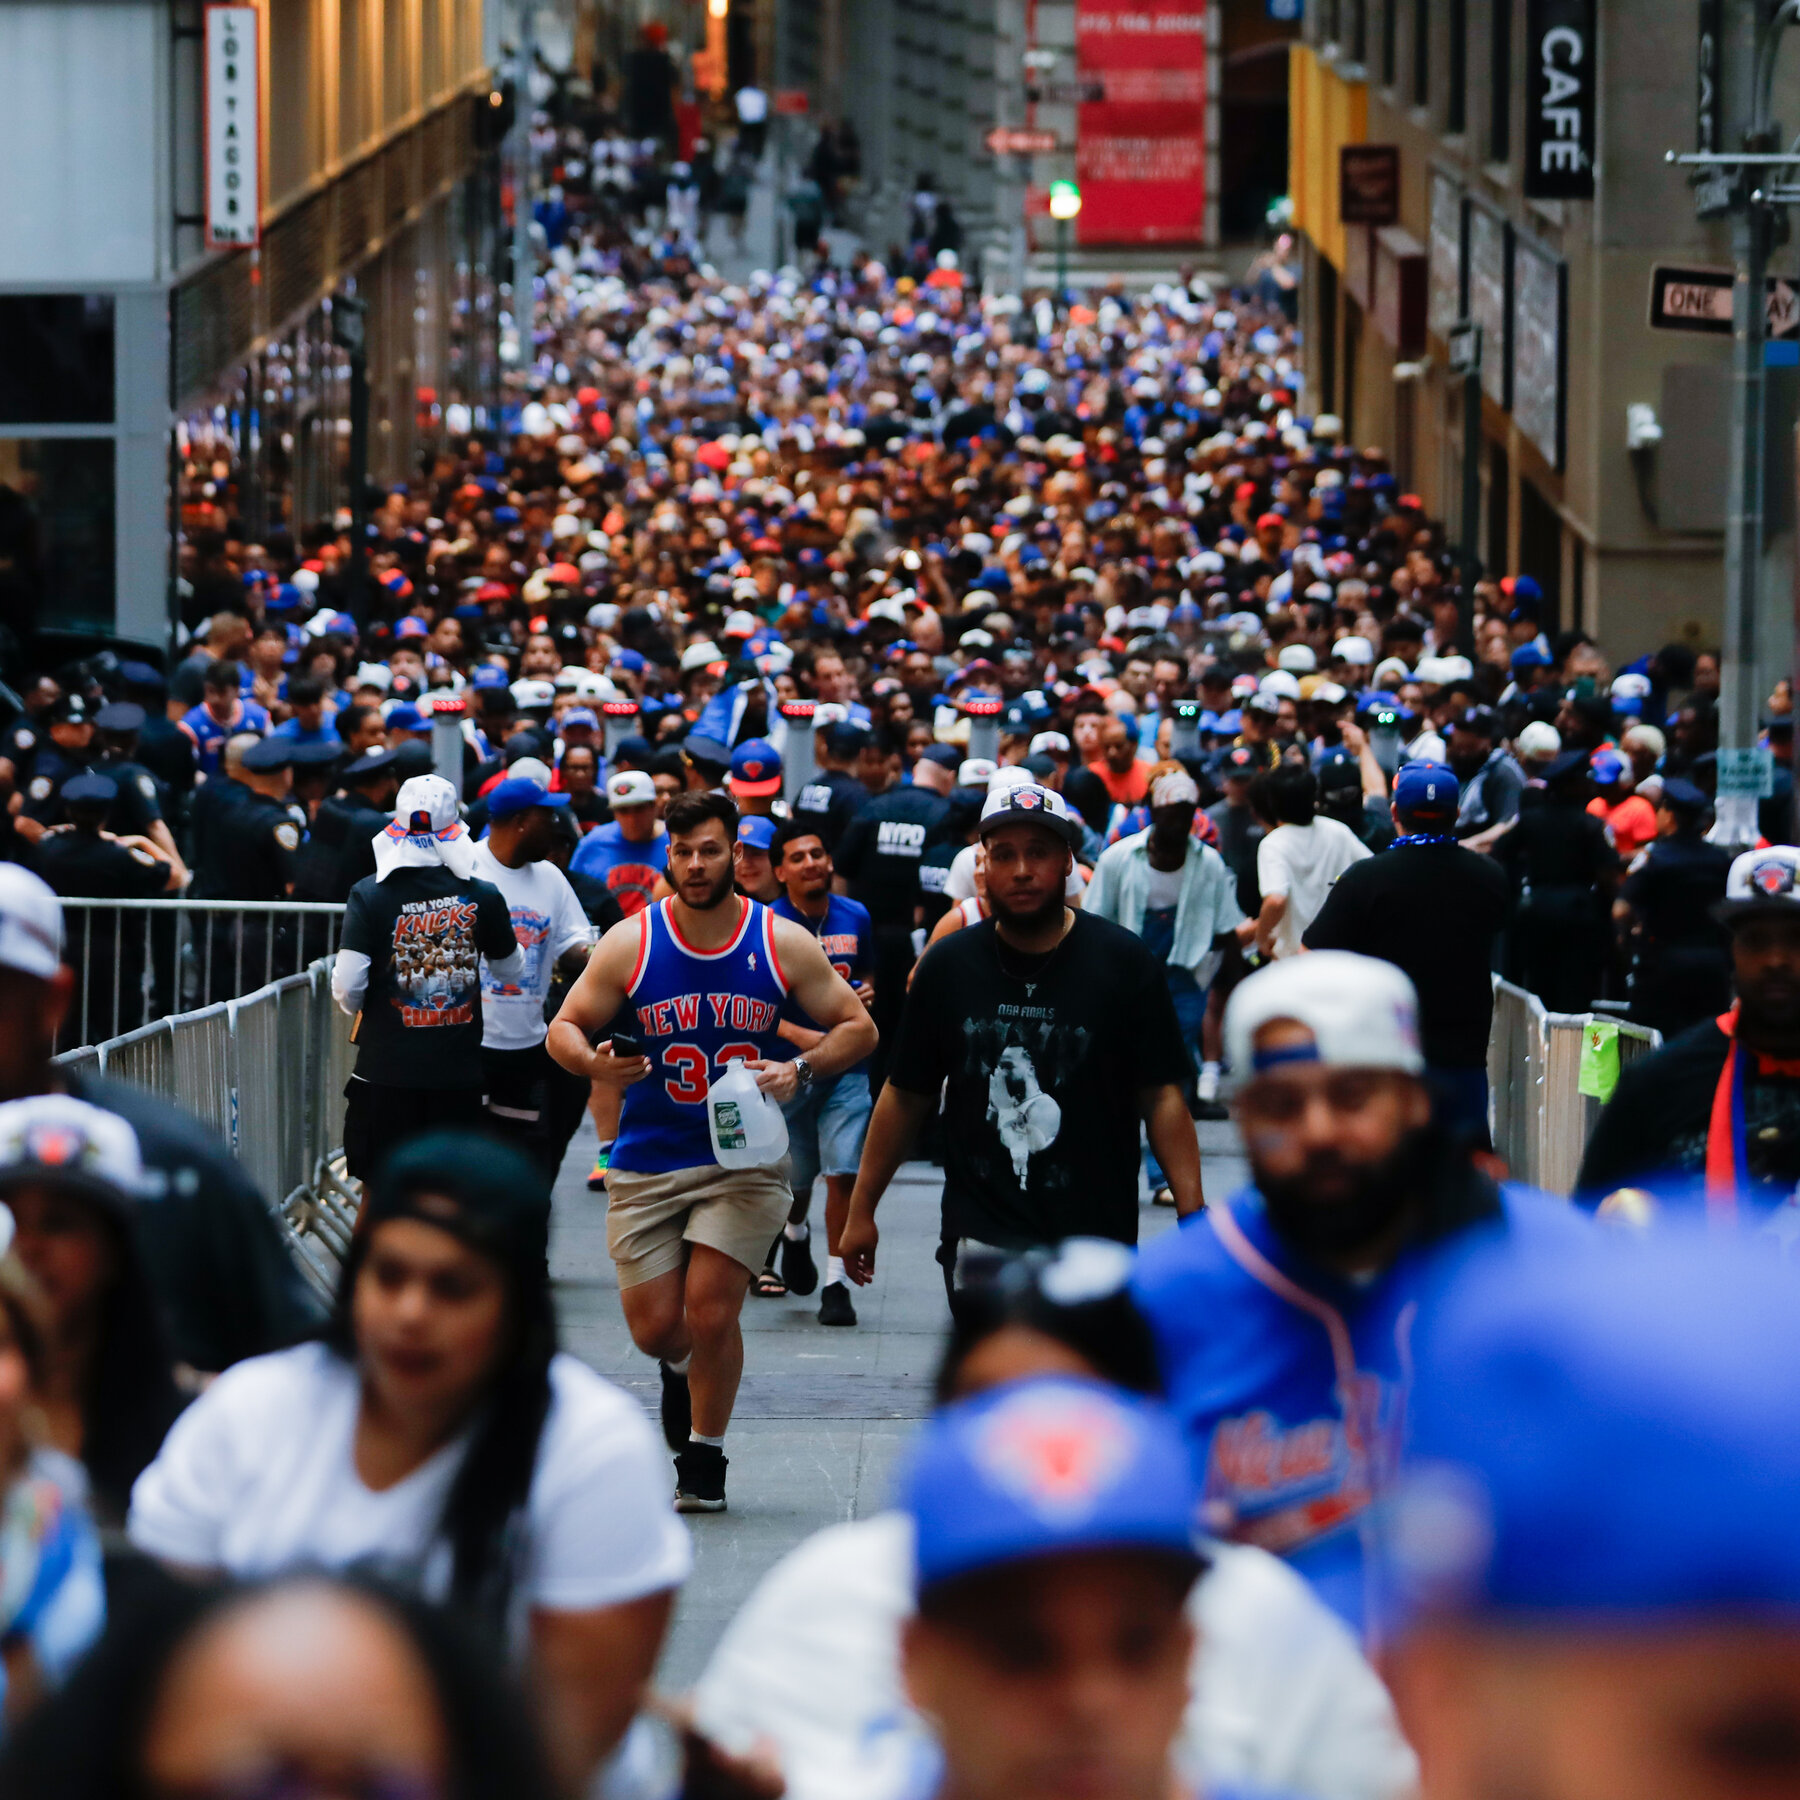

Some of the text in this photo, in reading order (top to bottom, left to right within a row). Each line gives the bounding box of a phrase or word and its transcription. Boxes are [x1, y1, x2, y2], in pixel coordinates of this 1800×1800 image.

[1669, 284, 1793, 320] ONE AY
[877, 821, 926, 846] NYPD
[402, 896, 461, 913] NEW YORK
[391, 902, 479, 949] KNICKS
[636, 993, 701, 1036] NEW
[998, 1003, 1055, 1020] NBA FINALS
